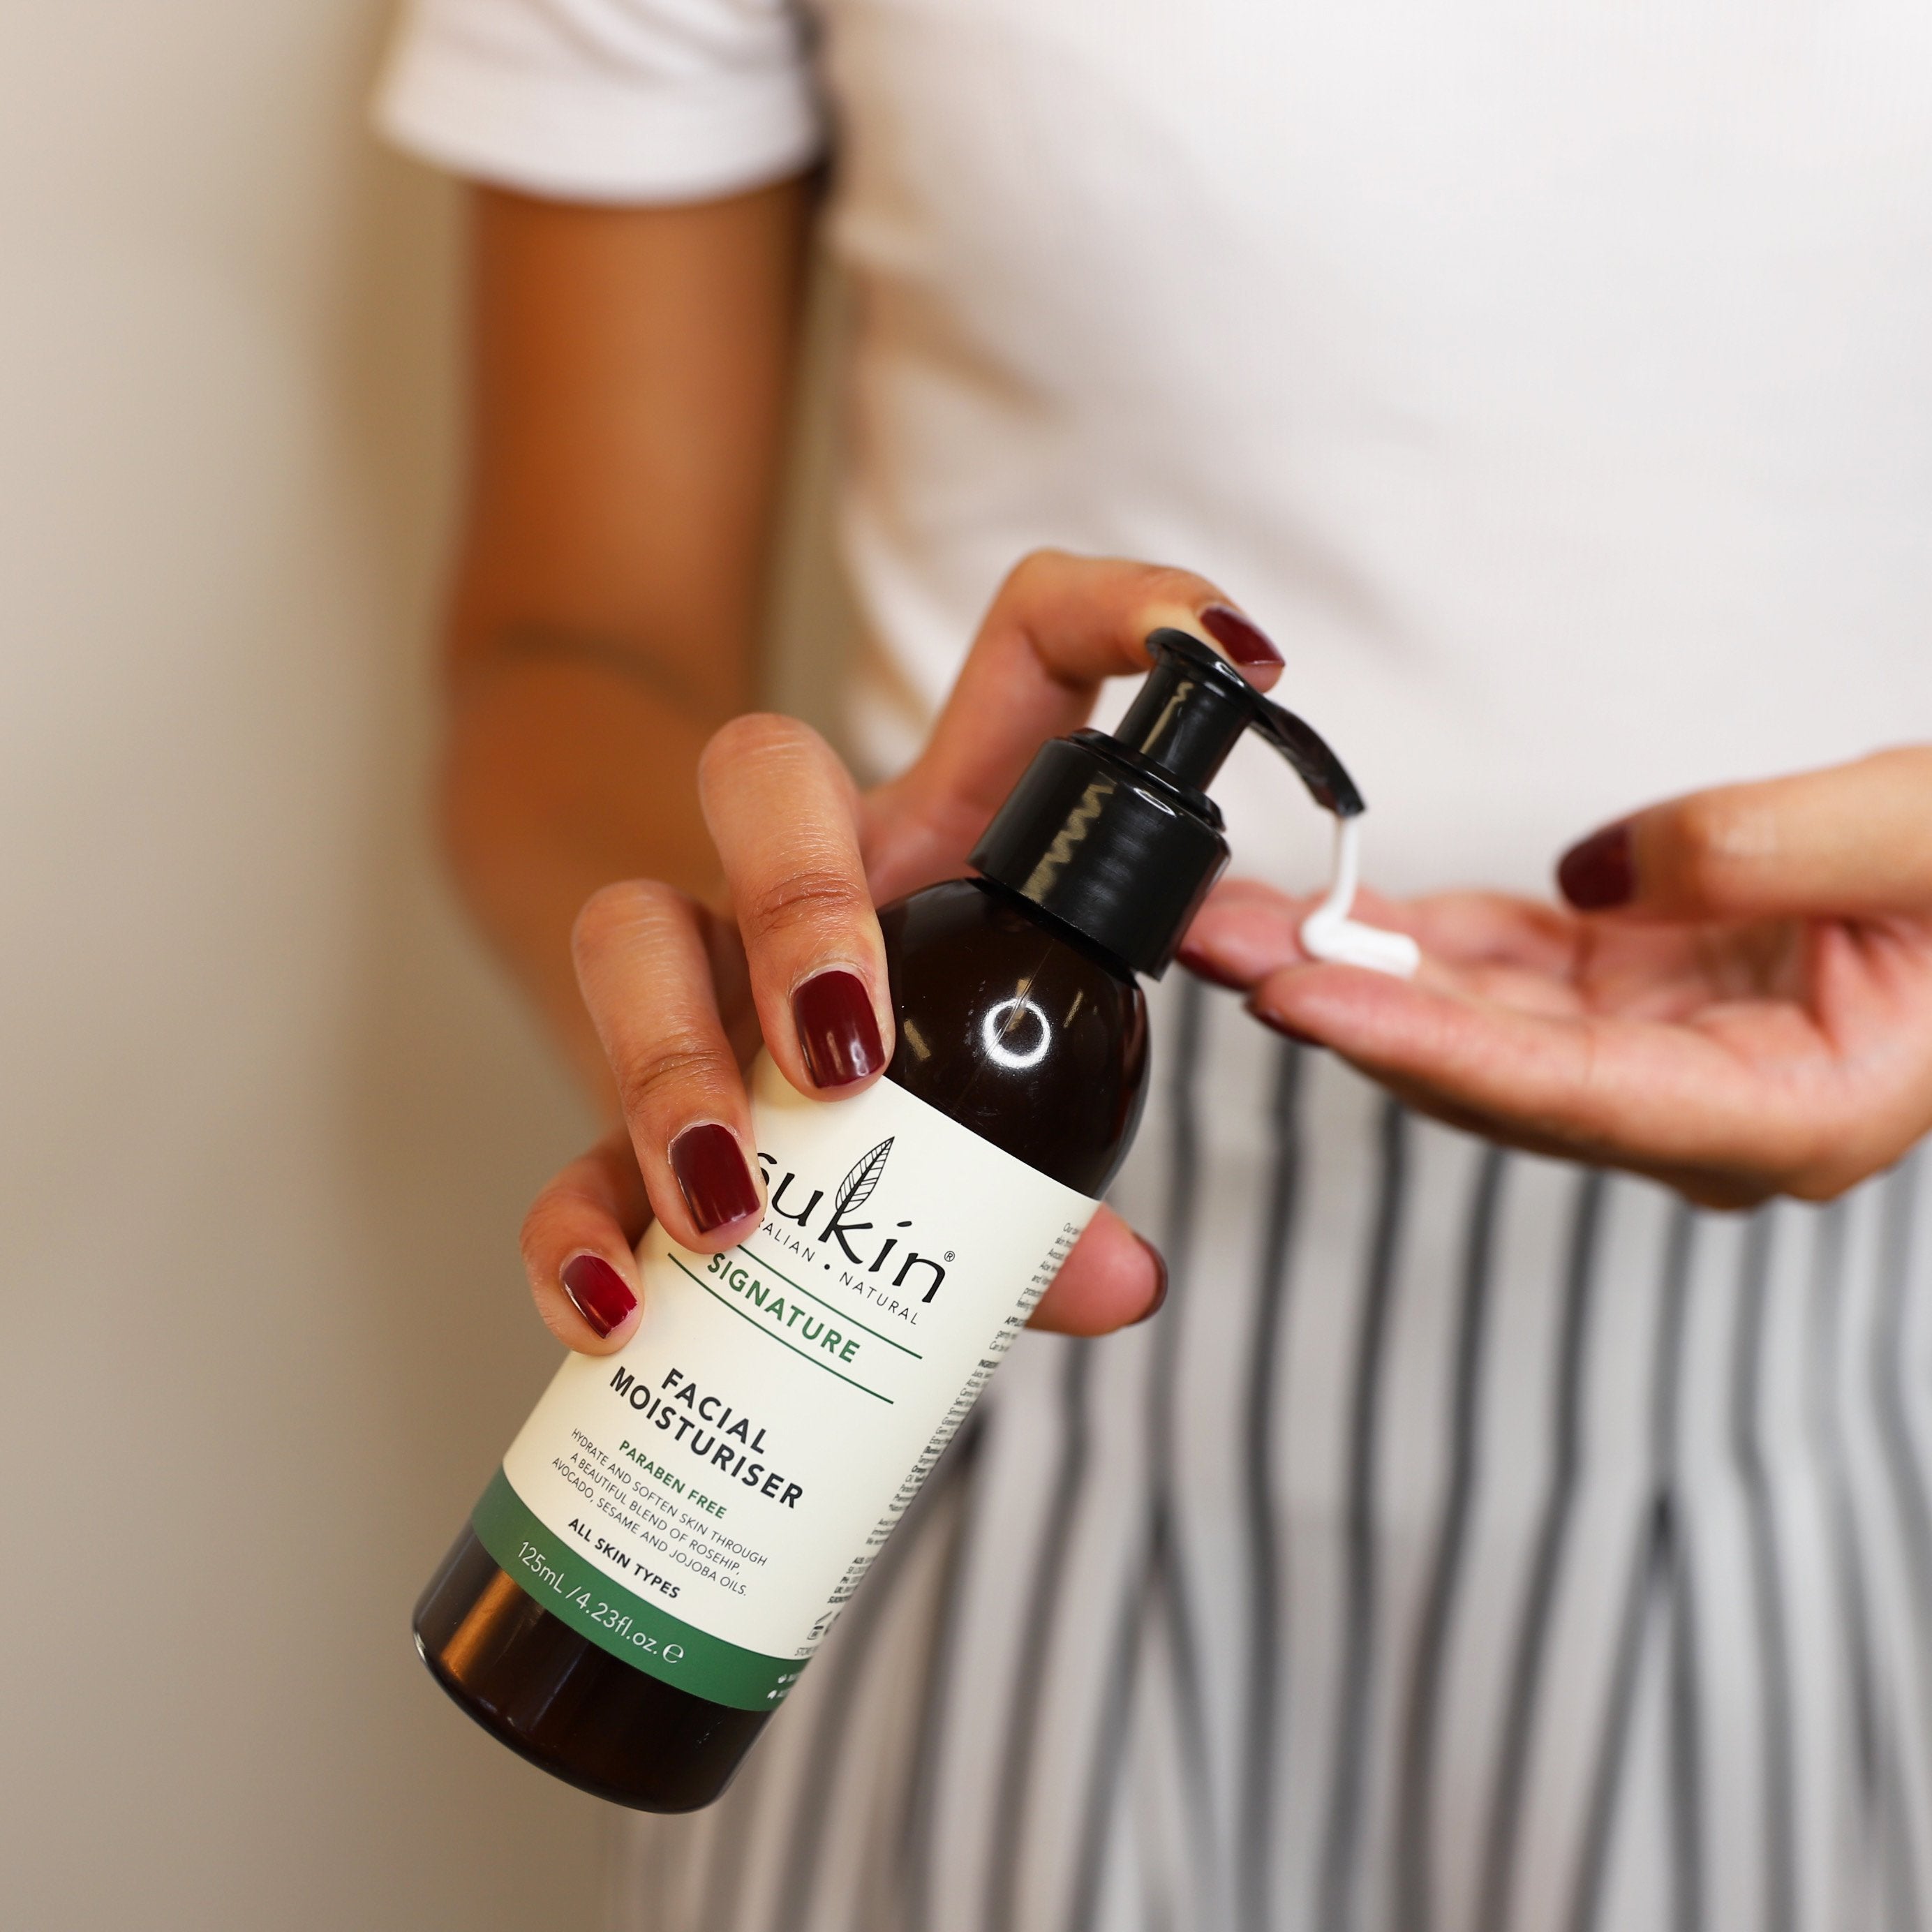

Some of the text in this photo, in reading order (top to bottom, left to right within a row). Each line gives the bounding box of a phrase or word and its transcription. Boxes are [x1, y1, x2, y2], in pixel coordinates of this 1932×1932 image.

[708, 1253, 860, 1363] SIGNATURE
[839, 1272, 917, 1325] NATURAL
[609, 1366, 803, 1509] MOISTURISER
[661, 1368, 766, 1455] FACIAL
[552, 1458, 747, 1596] AVOCADO, SESAME AND JOJOBA OILS.
[570, 1451, 740, 1575] A BEAUTIFUL BLEND OF ROSEHIP,
[572, 1428, 768, 1566] HYDRATE AND SOFTEN SKIN THROUGH
[619, 1440, 727, 1519] PARABEN FREE
[519, 1540, 564, 1593] 125mL
[568, 1518, 681, 1598] ALL SKIN TYPES
